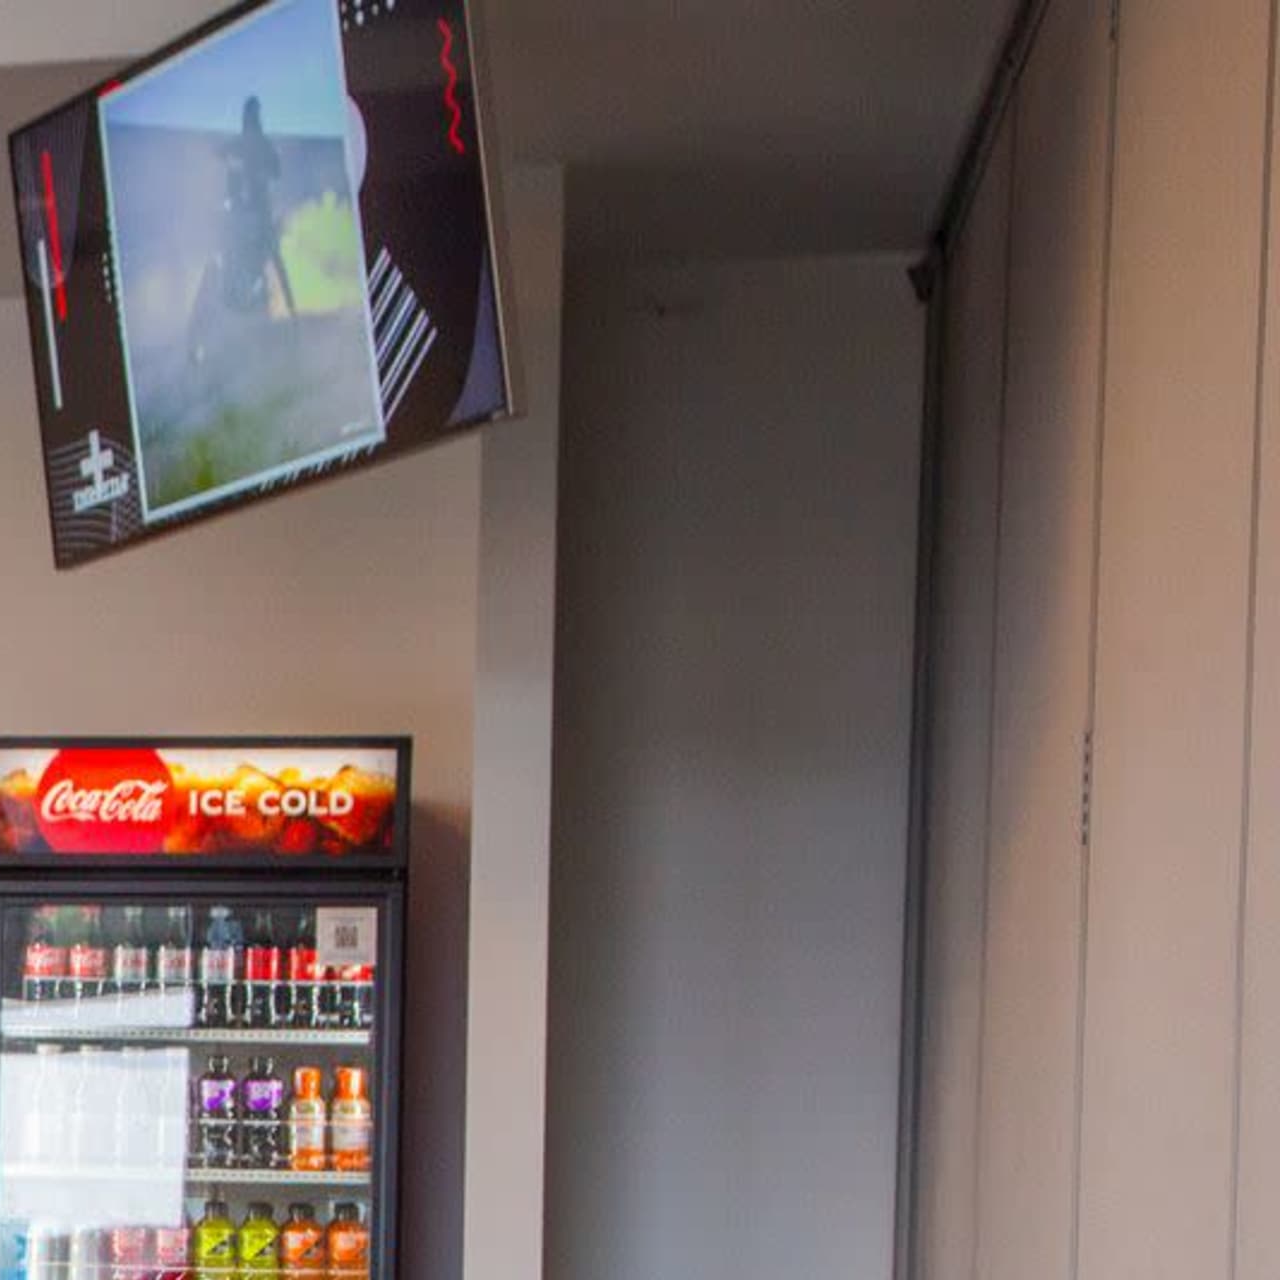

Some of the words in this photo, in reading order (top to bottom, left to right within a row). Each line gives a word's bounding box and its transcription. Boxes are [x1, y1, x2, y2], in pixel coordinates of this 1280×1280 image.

[41, 779, 168, 822] Coca-Cola
[189, 789, 246, 816] ICE
[257, 789, 354, 817] COLD
